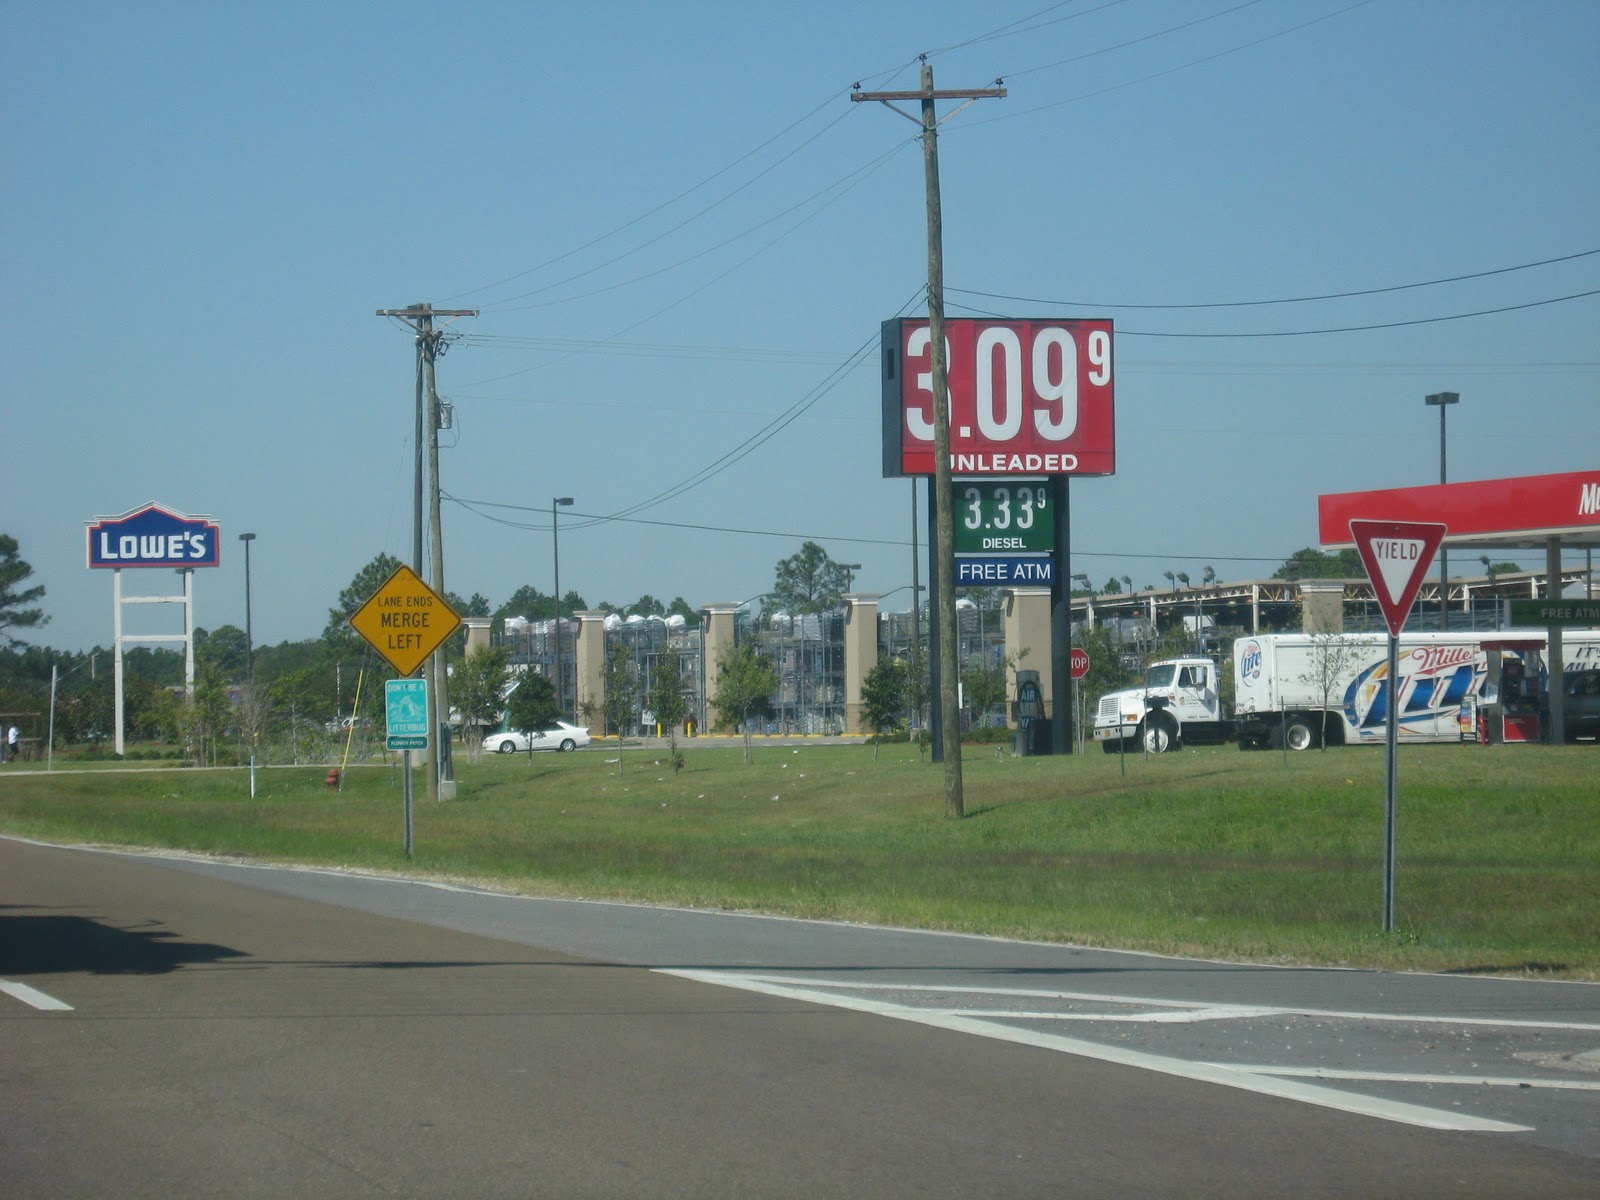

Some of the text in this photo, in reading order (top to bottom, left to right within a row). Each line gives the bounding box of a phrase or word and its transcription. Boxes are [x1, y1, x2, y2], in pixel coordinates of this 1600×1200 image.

[100, 531, 207, 559] LOWE'S
[982, 538, 1027, 549] DIESEL
[1376, 541, 1418, 560] YIELD
[960, 563, 1051, 580] FREE ATM
[377, 596, 433, 608] LANE ENDS
[1541, 608, 1600, 619] FREE ATM
[381, 612, 430, 628] MERGE
[388, 634, 423, 650] LEFT
[1071, 657, 1088, 669] TOP
[388, 684, 406, 692] DON'T
[408, 684, 417, 692] BE
[1021, 689, 1036, 701] AIR
[389, 724, 426, 732] LITTERBUG
